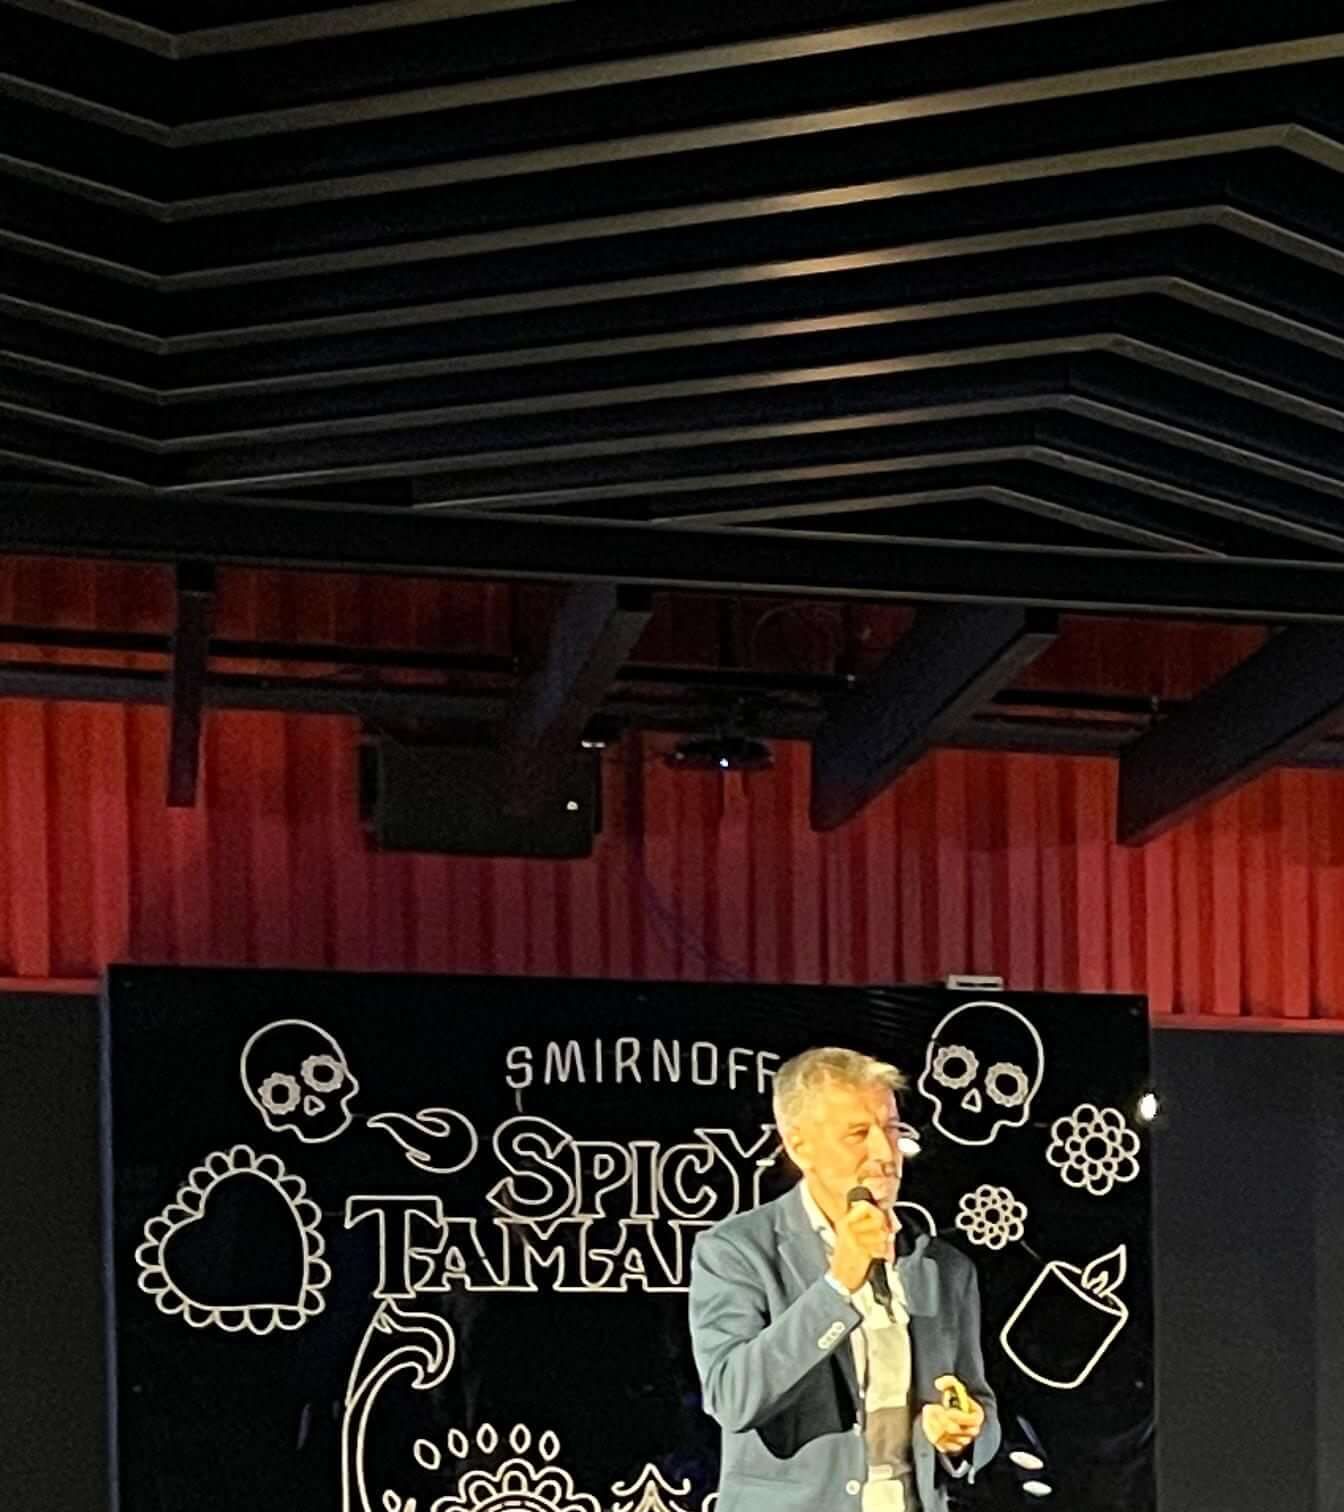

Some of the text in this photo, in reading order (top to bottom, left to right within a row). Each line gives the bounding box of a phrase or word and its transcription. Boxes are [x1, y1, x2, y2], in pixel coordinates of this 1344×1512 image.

[505, 1037, 781, 1094] SMIRNOFF
[486, 1115, 792, 1220] SPICY
[344, 1195, 714, 1299] TAMA
